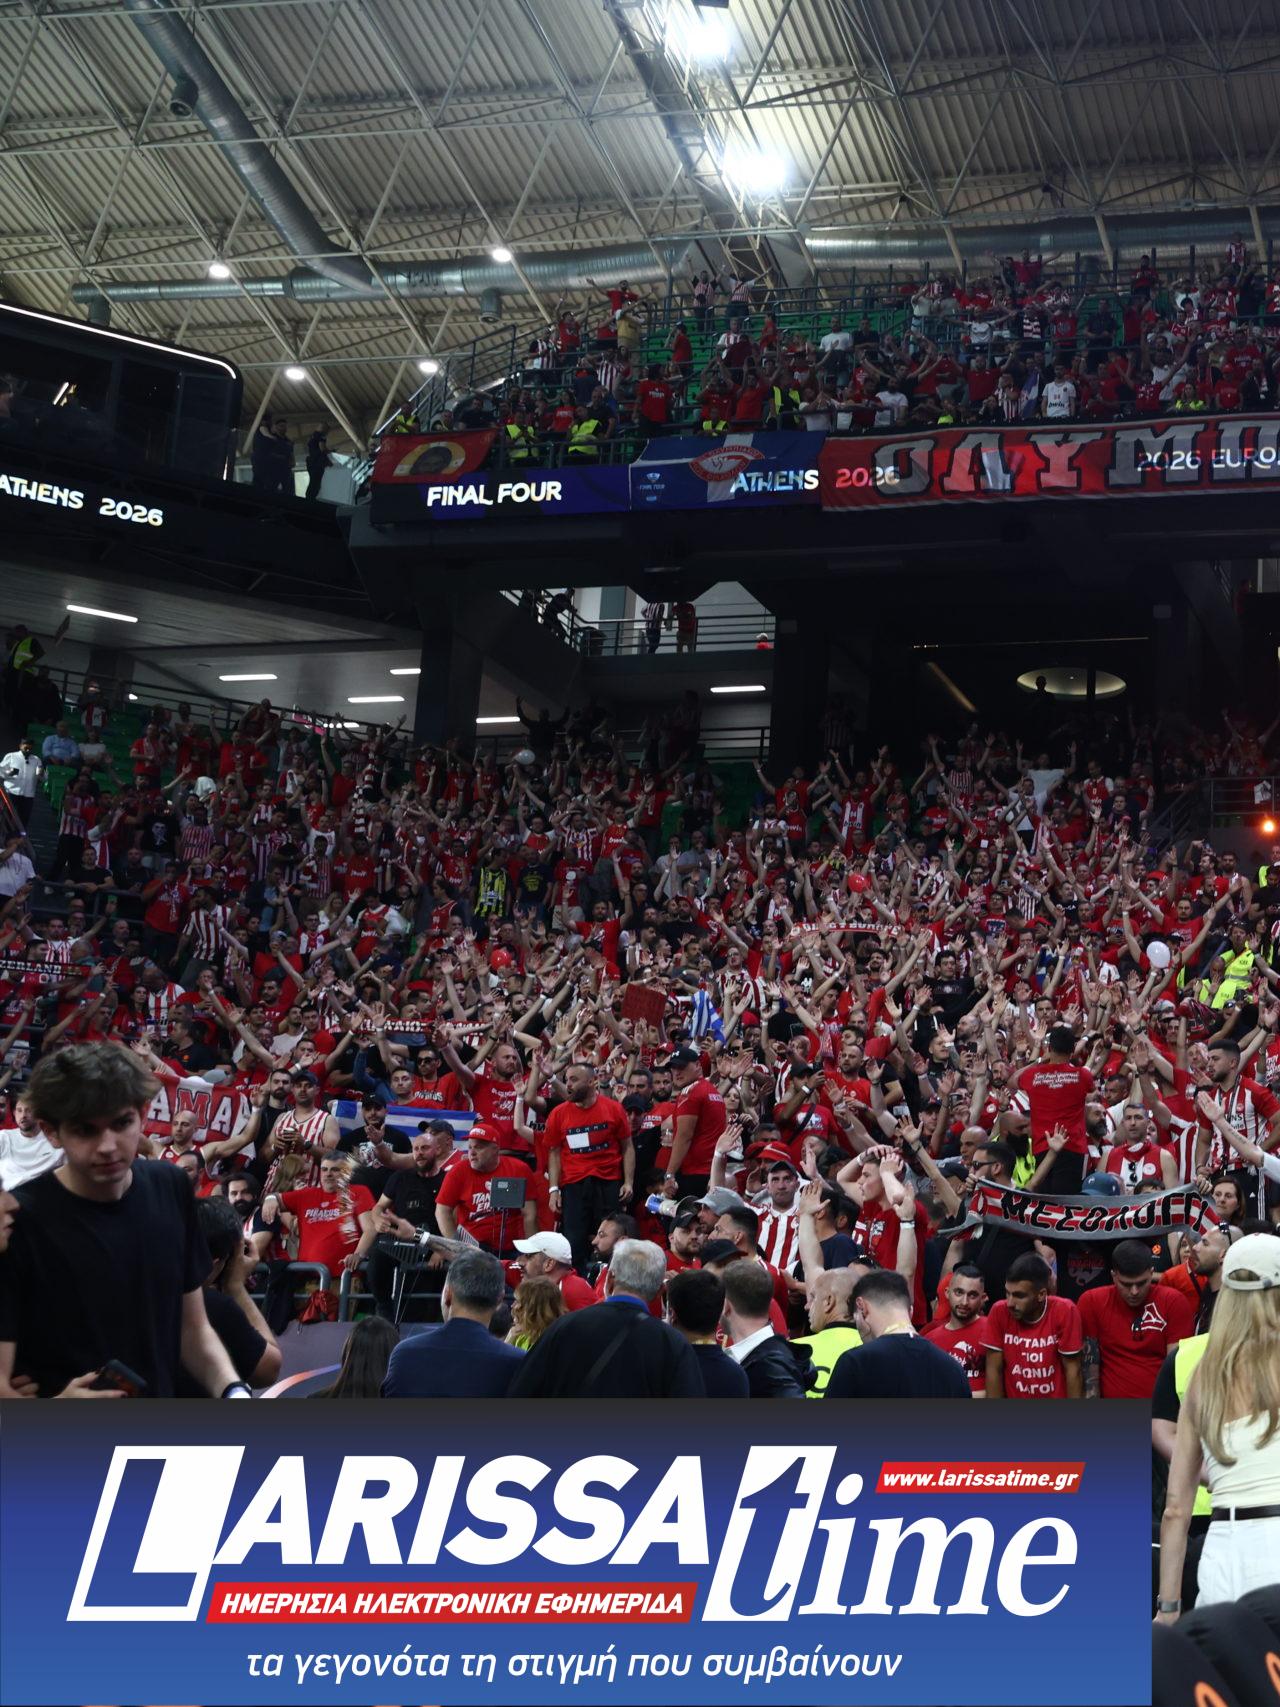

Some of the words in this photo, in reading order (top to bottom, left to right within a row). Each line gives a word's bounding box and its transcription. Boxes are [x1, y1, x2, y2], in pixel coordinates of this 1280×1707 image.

[1137, 450, 1201, 472] 2026
[426, 484, 493, 508] FINAL
[496, 480, 562, 504] FOUR
[729, 468, 819, 494] ATHENS
[0, 473, 84, 510] ATHENS
[99, 497, 164, 527] 2026
